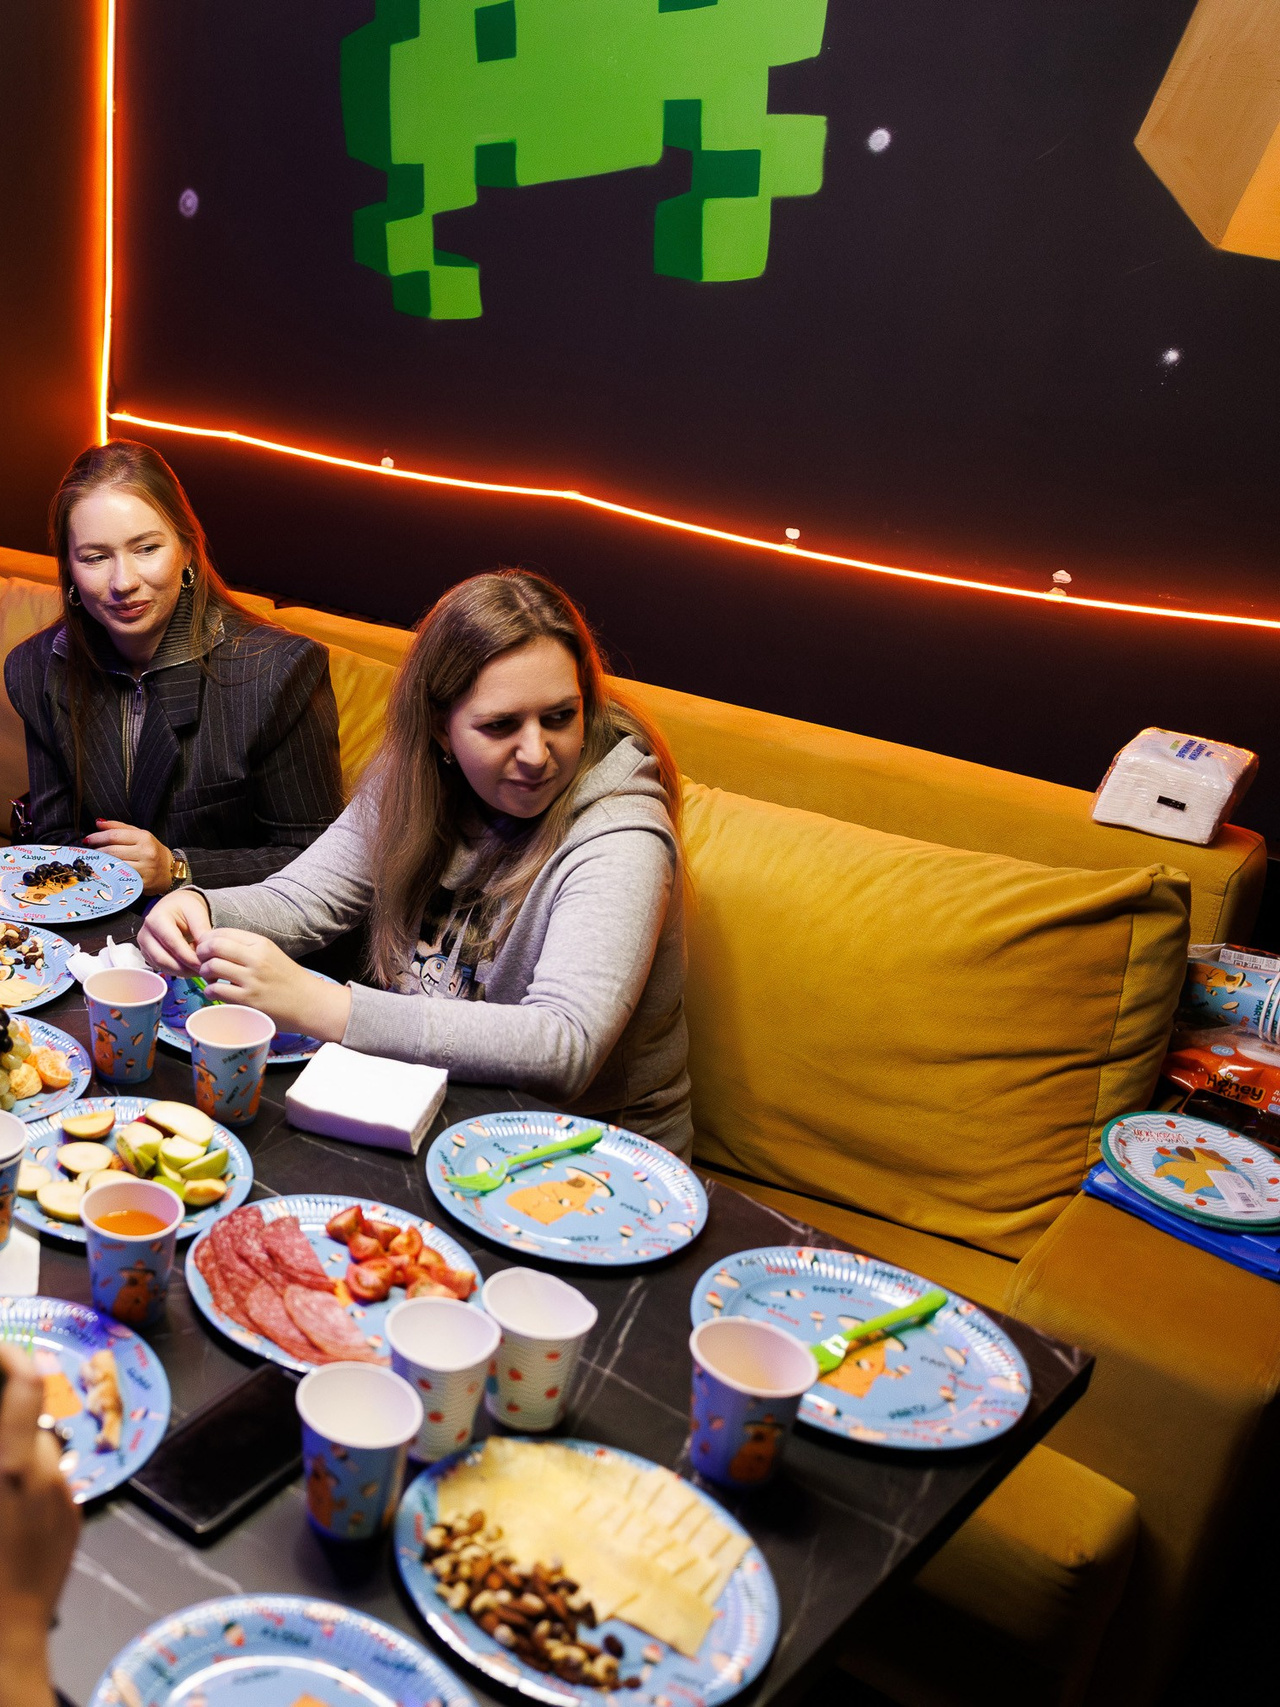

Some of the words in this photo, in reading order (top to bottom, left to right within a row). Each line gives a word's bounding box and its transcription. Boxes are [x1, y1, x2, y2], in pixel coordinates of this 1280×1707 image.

[12, 846, 33, 855] BARA
[68, 847, 87, 855] BARA
[37, 1025, 60, 1040] PARTY
[442, 1023, 457, 1058] adida
[1206, 1073, 1264, 1101] Honey
[618, 1135, 650, 1150] PARTY
[765, 1264, 797, 1277] BARA
[812, 1285, 853, 1295] PARTY
